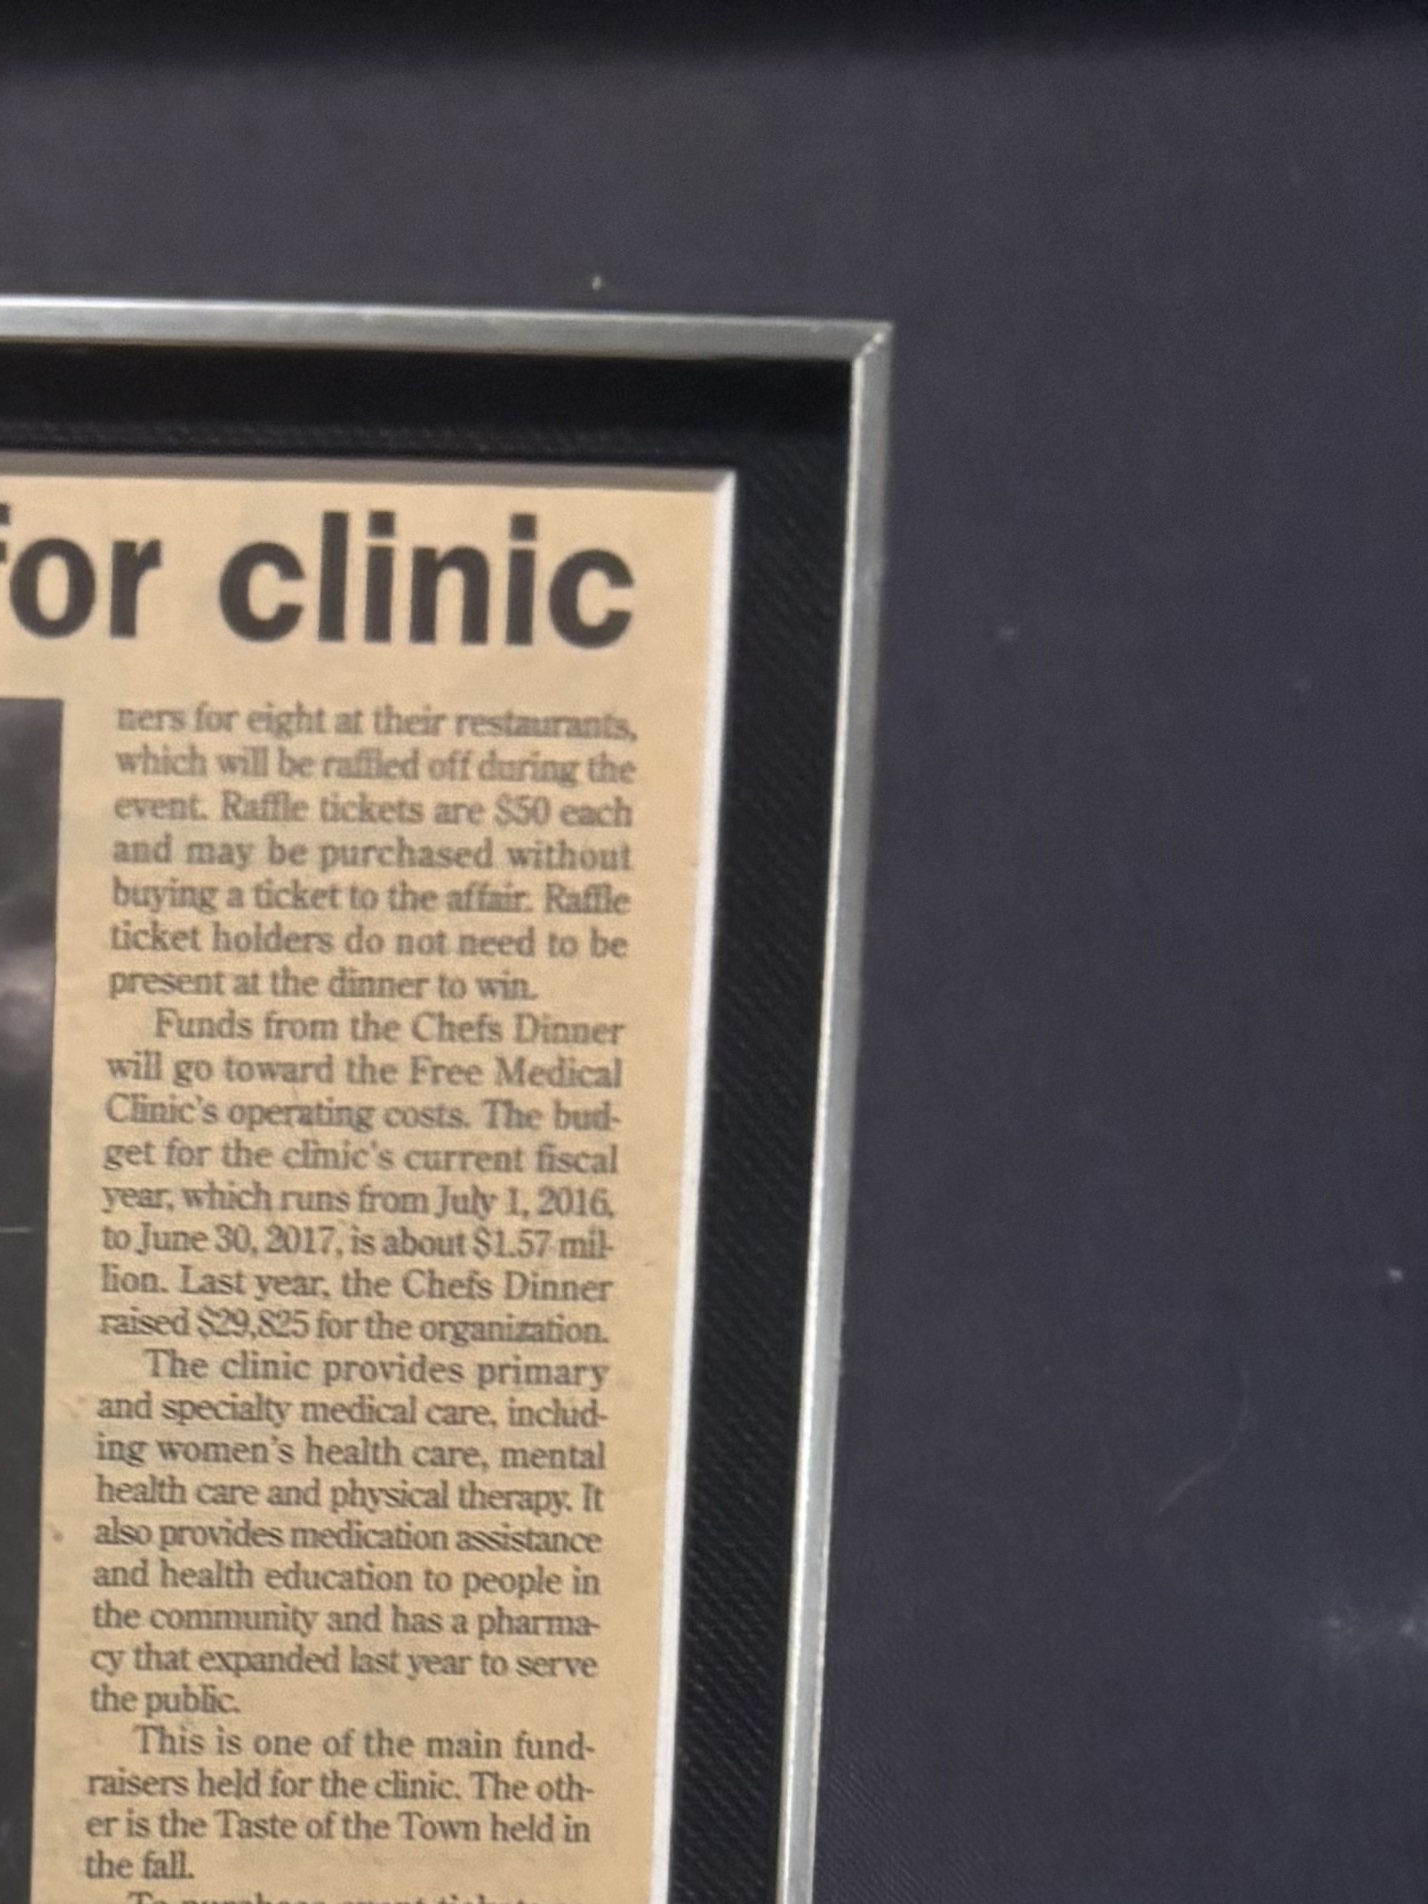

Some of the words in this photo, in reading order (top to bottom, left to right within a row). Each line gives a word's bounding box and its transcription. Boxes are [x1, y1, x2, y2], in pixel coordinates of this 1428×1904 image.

[217, 508, 636, 651] clinic
[112, 792, 210, 822] event.
[219, 787, 310, 823] Raffle
[319, 790, 426, 826] tickets
[432, 801, 486, 827] are
[492, 791, 552, 829] $50
[558, 794, 634, 829] each
[141, 1346, 210, 1384] The
[218, 1347, 312, 1382] clinic
[321, 1350, 466, 1389] provides
[474, 1352, 612, 1394] primary
